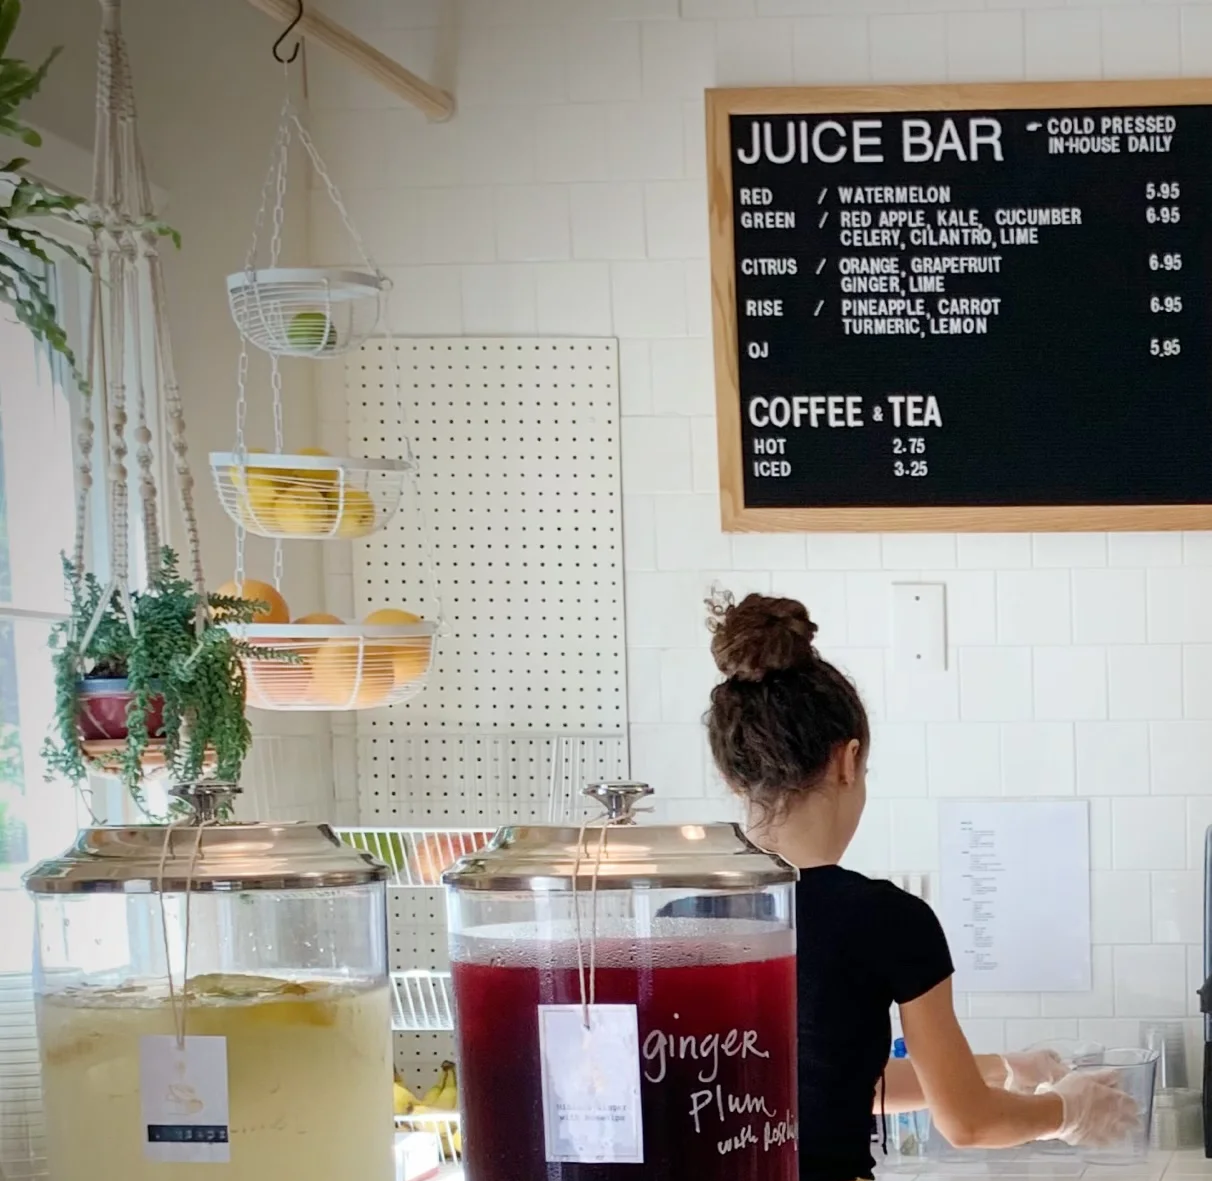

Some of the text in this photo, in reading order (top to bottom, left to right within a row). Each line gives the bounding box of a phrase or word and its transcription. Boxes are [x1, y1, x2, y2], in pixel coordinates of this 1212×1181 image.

[1047, 116, 1176, 135] COLD PRESSED
[737, 117, 1004, 164] JUICE BAR
[1049, 135, 1172, 154] IN-HOUSE DAILY
[740, 188, 773, 205] RED
[838, 186, 950, 204] WATERMELON
[1146, 182, 1180, 200] 5.95
[741, 211, 795, 228] GREEN
[841, 211, 871, 228] RED
[995, 208, 1082, 225] CUCUMBER
[1146, 207, 1180, 223] 6.95
[1000, 227, 1038, 245] LIME
[741, 258, 797, 275] CITRUS
[911, 256, 1002, 273] GRAPEFRUIT
[1149, 254, 1182, 270] 6.95
[909, 275, 945, 292] LIME
[746, 300, 783, 316] RISE
[938, 298, 1001, 315] CARROT
[1150, 296, 1182, 313] 6.95
[930, 317, 987, 334] LEMON
[748, 339, 1180, 359] OJ 5.95
[749, 395, 942, 428] COFFEE & TEA
[754, 438, 925, 454] HOT 2.75
[754, 460, 928, 477] ICED 3.25
